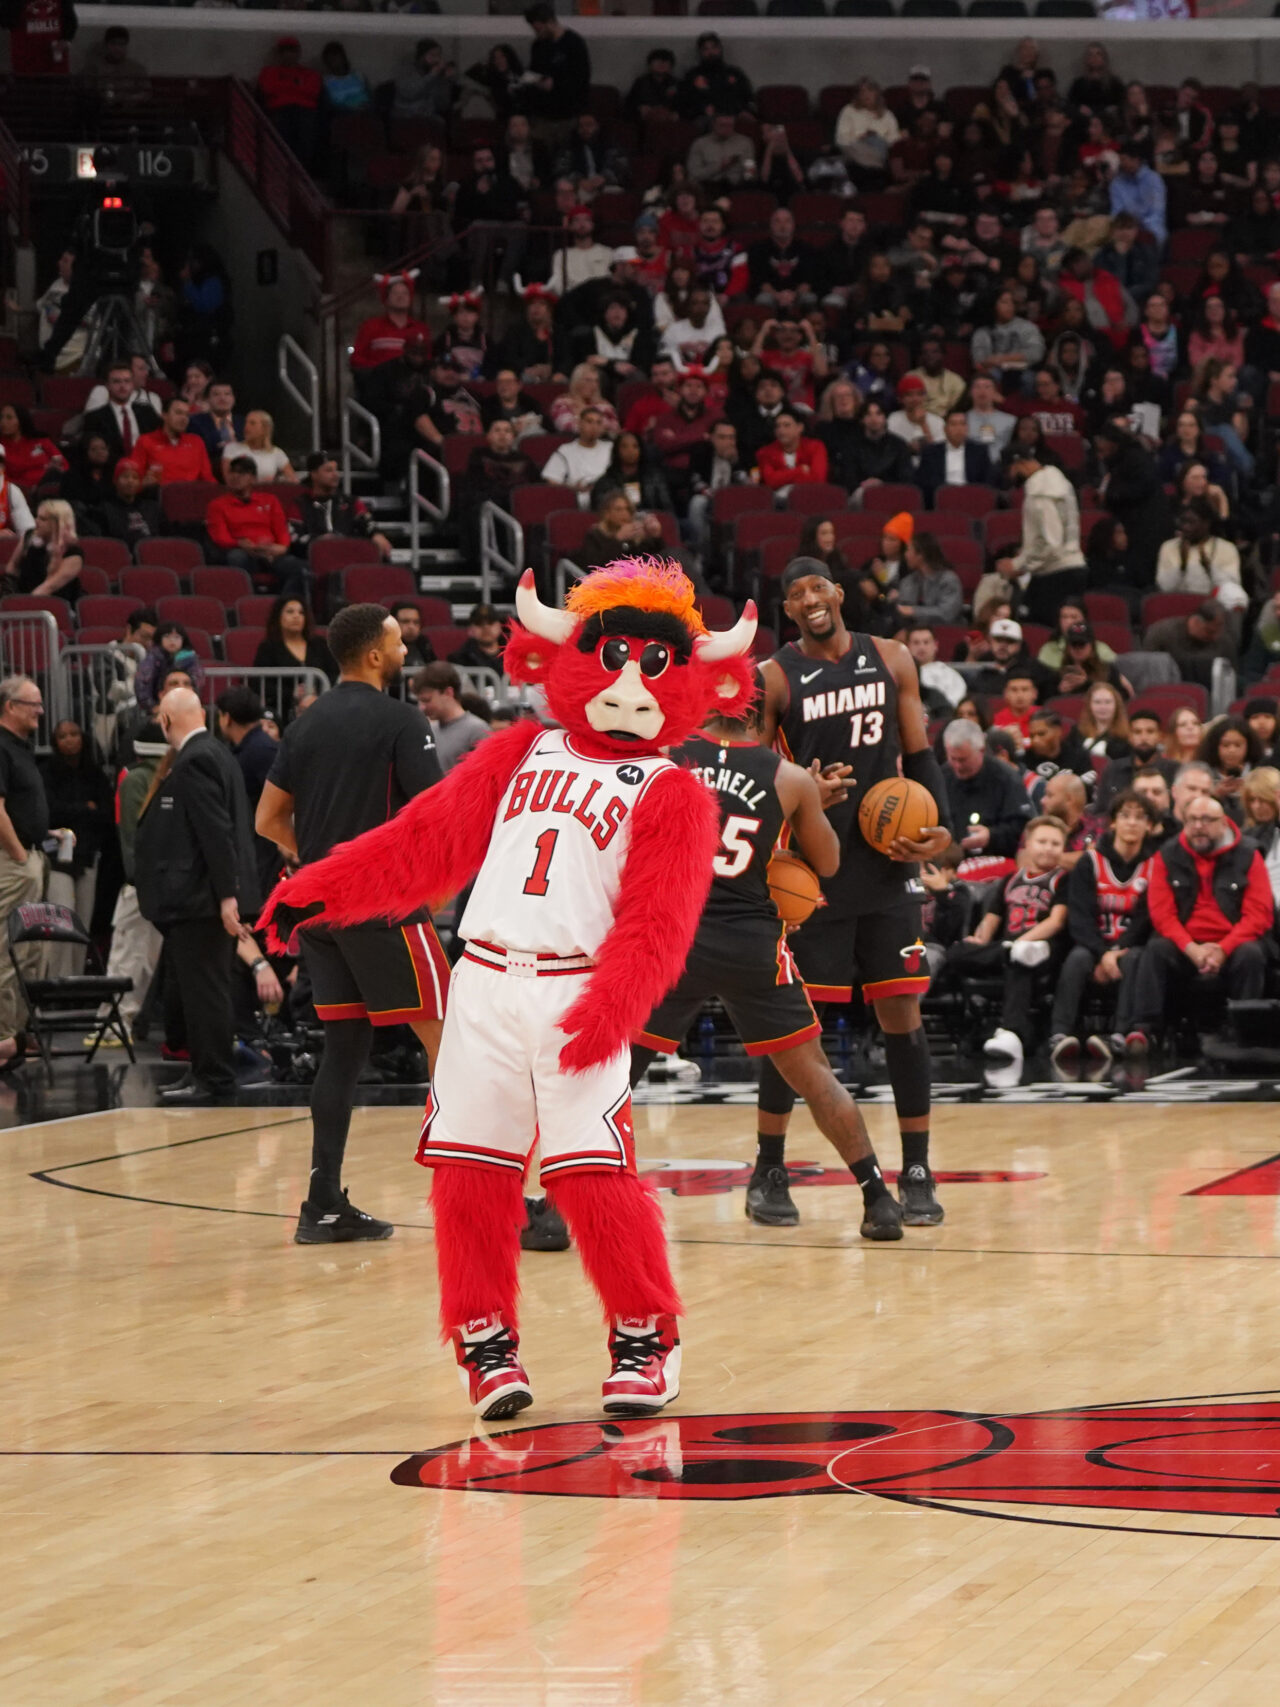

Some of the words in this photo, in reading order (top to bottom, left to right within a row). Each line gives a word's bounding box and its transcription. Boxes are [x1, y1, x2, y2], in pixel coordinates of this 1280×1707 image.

[138, 149, 172, 176] 116
[802, 681, 886, 723] MIAMI
[849, 710, 885, 749] 13
[503, 769, 629, 851] BULLS
[522, 828, 560, 897] 1
